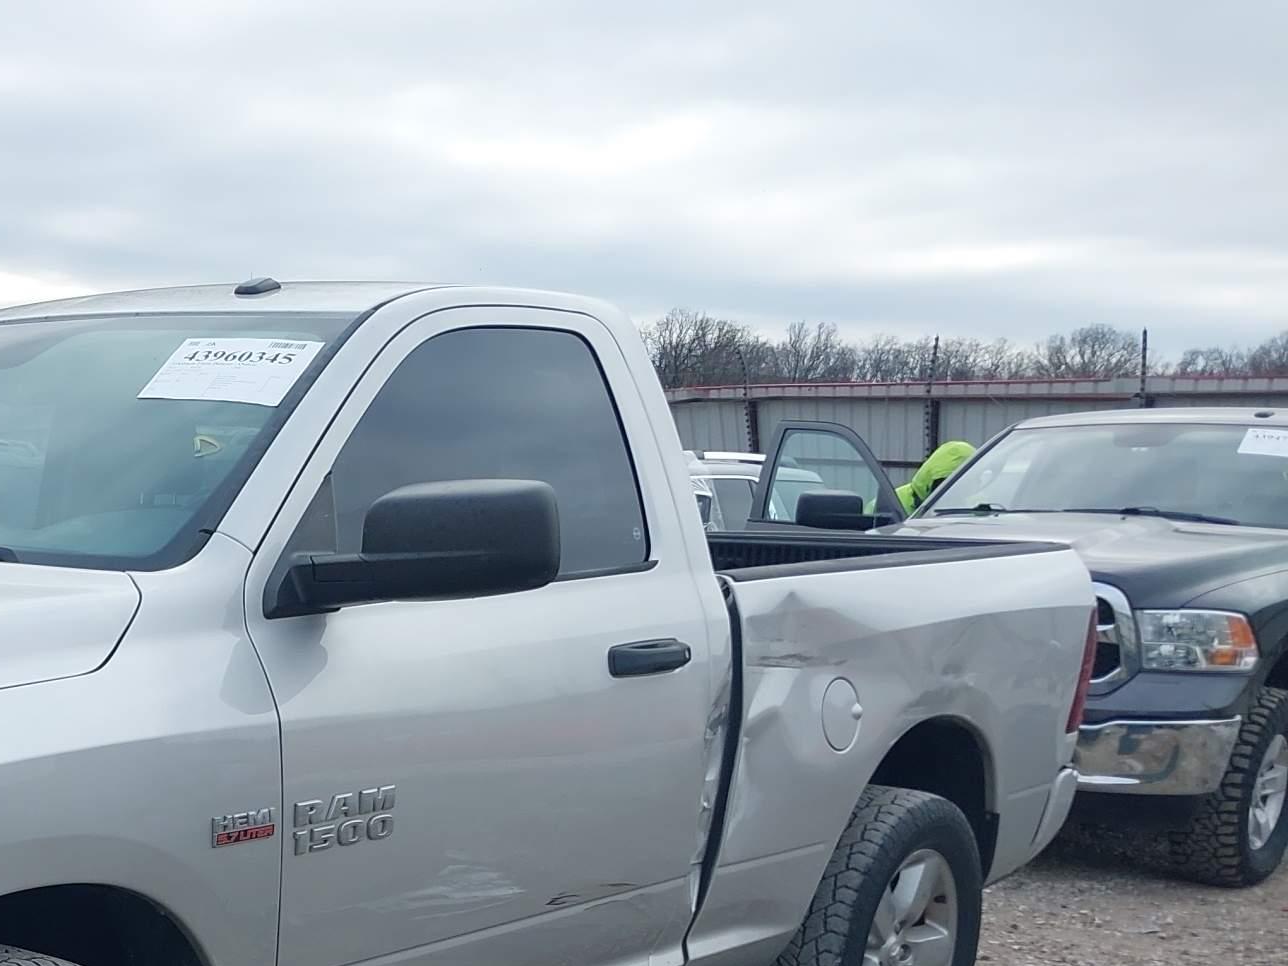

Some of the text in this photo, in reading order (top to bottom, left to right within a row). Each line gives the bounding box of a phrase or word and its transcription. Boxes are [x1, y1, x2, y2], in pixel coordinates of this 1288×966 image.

[183, 350, 297, 365] 43960345
[293, 784, 396, 828] RAM
[239, 825, 274, 841] LITER
[292, 814, 395, 857] 1500
